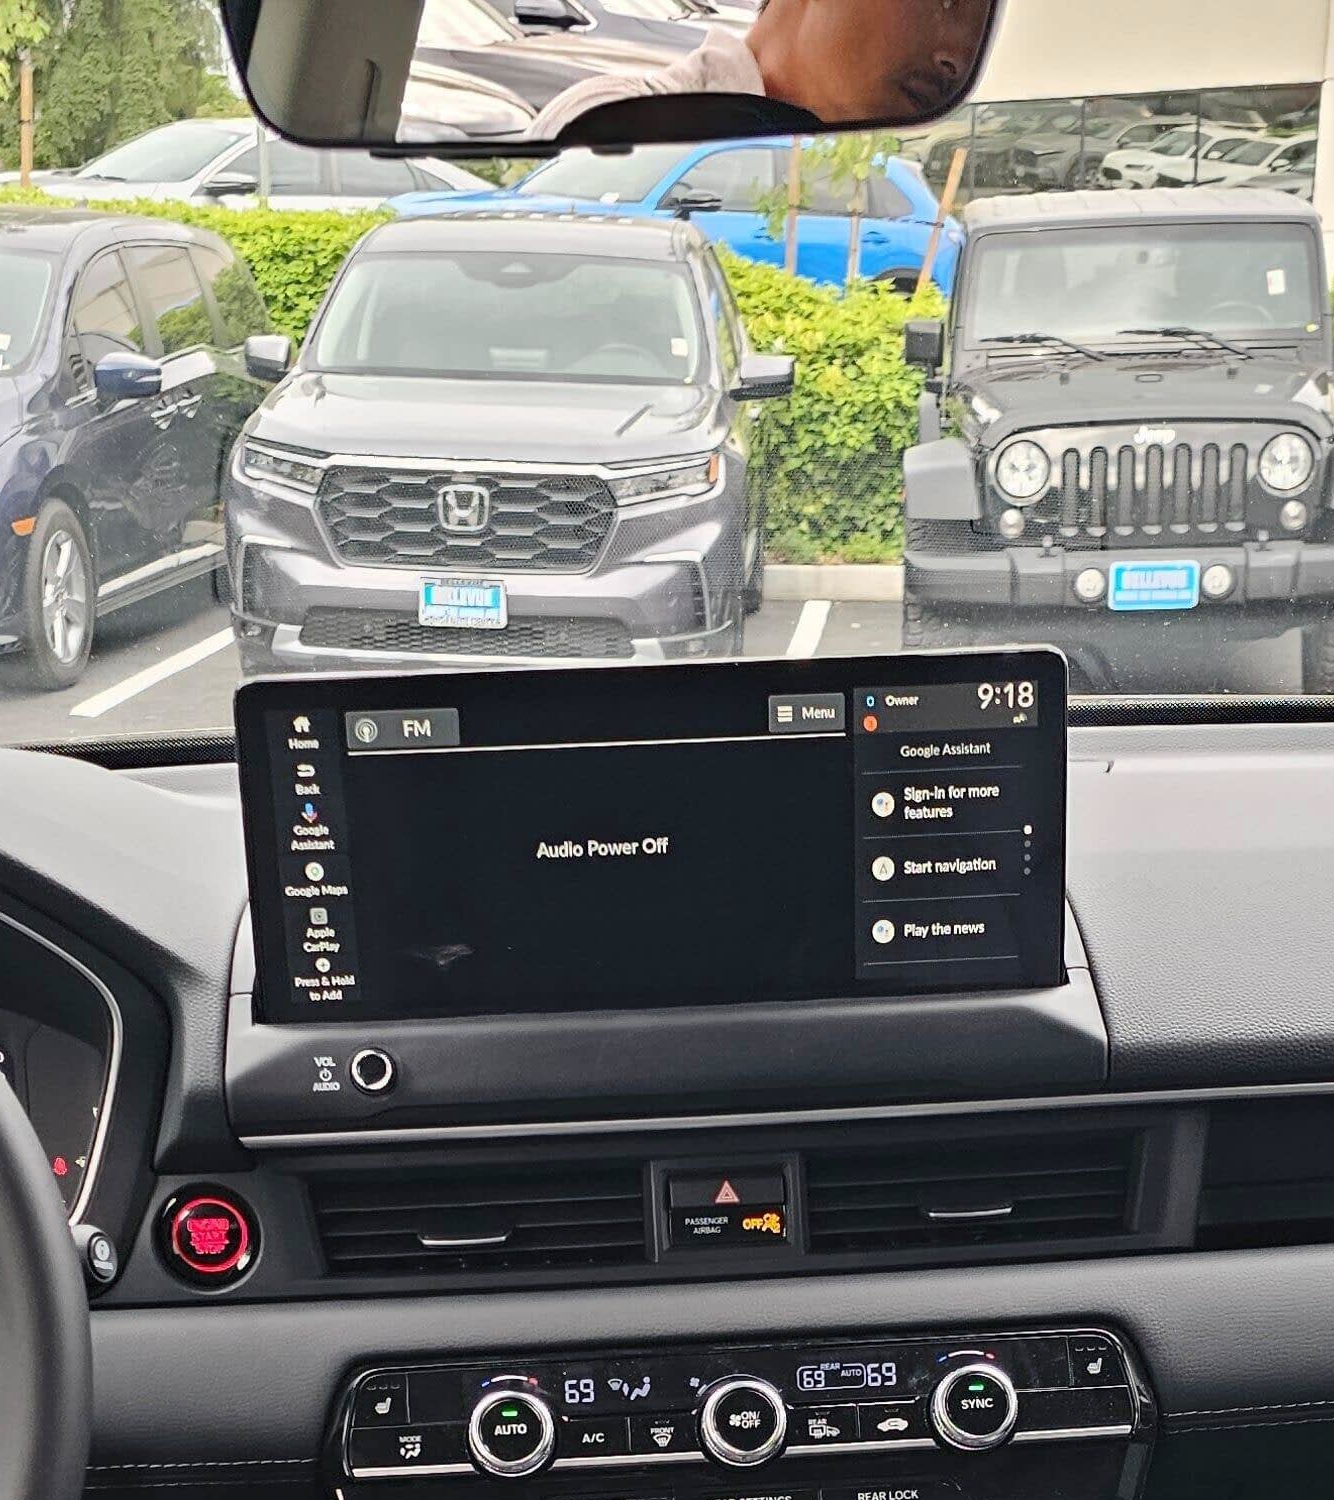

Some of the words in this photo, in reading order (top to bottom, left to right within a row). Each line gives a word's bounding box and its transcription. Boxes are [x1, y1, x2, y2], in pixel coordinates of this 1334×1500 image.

[1133, 425, 1176, 445] Jeep
[885, 694, 919, 707] Owner
[977, 681, 1034, 710] 9:18
[802, 706, 835, 720] Menu
[402, 719, 432, 738] FM
[288, 738, 319, 750] Home
[900, 745, 940, 759] Google
[942, 742, 991, 756] Assistant
[295, 784, 321, 795] Back
[903, 785, 946, 803] Sign-in
[948, 785, 966, 799] for
[968, 785, 1000, 798] more
[904, 806, 953, 820] features
[293, 824, 329, 837] Google
[291, 839, 335, 851] Assistant
[536, 840, 584, 859] Audio
[587, 840, 639, 857] Power
[642, 836, 669, 854] Off
[903, 861, 933, 874] Start
[935, 857, 997, 874] navigation
[285, 886, 320, 898] Google
[321, 885, 348, 897] Maps
[306, 927, 335, 939] Apple
[903, 924, 929, 938] Play
[931, 922, 951, 936] the
[953, 923, 985, 935] news
[303, 941, 341, 953] CarPlay
[294, 976, 320, 987] Press
[321, 976, 330, 986] &
[331, 975, 355, 986] Hold
[309, 990, 321, 1001] to
[322, 989, 343, 1000] Add
[313, 1056, 336, 1067] VOL
[312, 1081, 340, 1092] AUDIO
[685, 1216, 729, 1226] PASSENGER
[742, 1218, 763, 1230] OFF
[693, 1226, 722, 1235] AIRBAG
[820, 1362, 841, 1371] REAR
[802, 1370, 826, 1389] 69
[840, 1369, 862, 1378] AUTO
[867, 1362, 897, 1387] 69
[564, 1378, 595, 1404] 69
[961, 1398, 994, 1410] SYNC
[740, 1411, 761, 1420] ON/
[494, 1423, 528, 1436] AUTO
[741, 1419, 761, 1429] OFF
[650, 1427, 674, 1436] FRONT
[399, 1435, 422, 1443] MODE
[582, 1432, 605, 1444] A/C
[889, 1490, 919, 1500] LOCK
